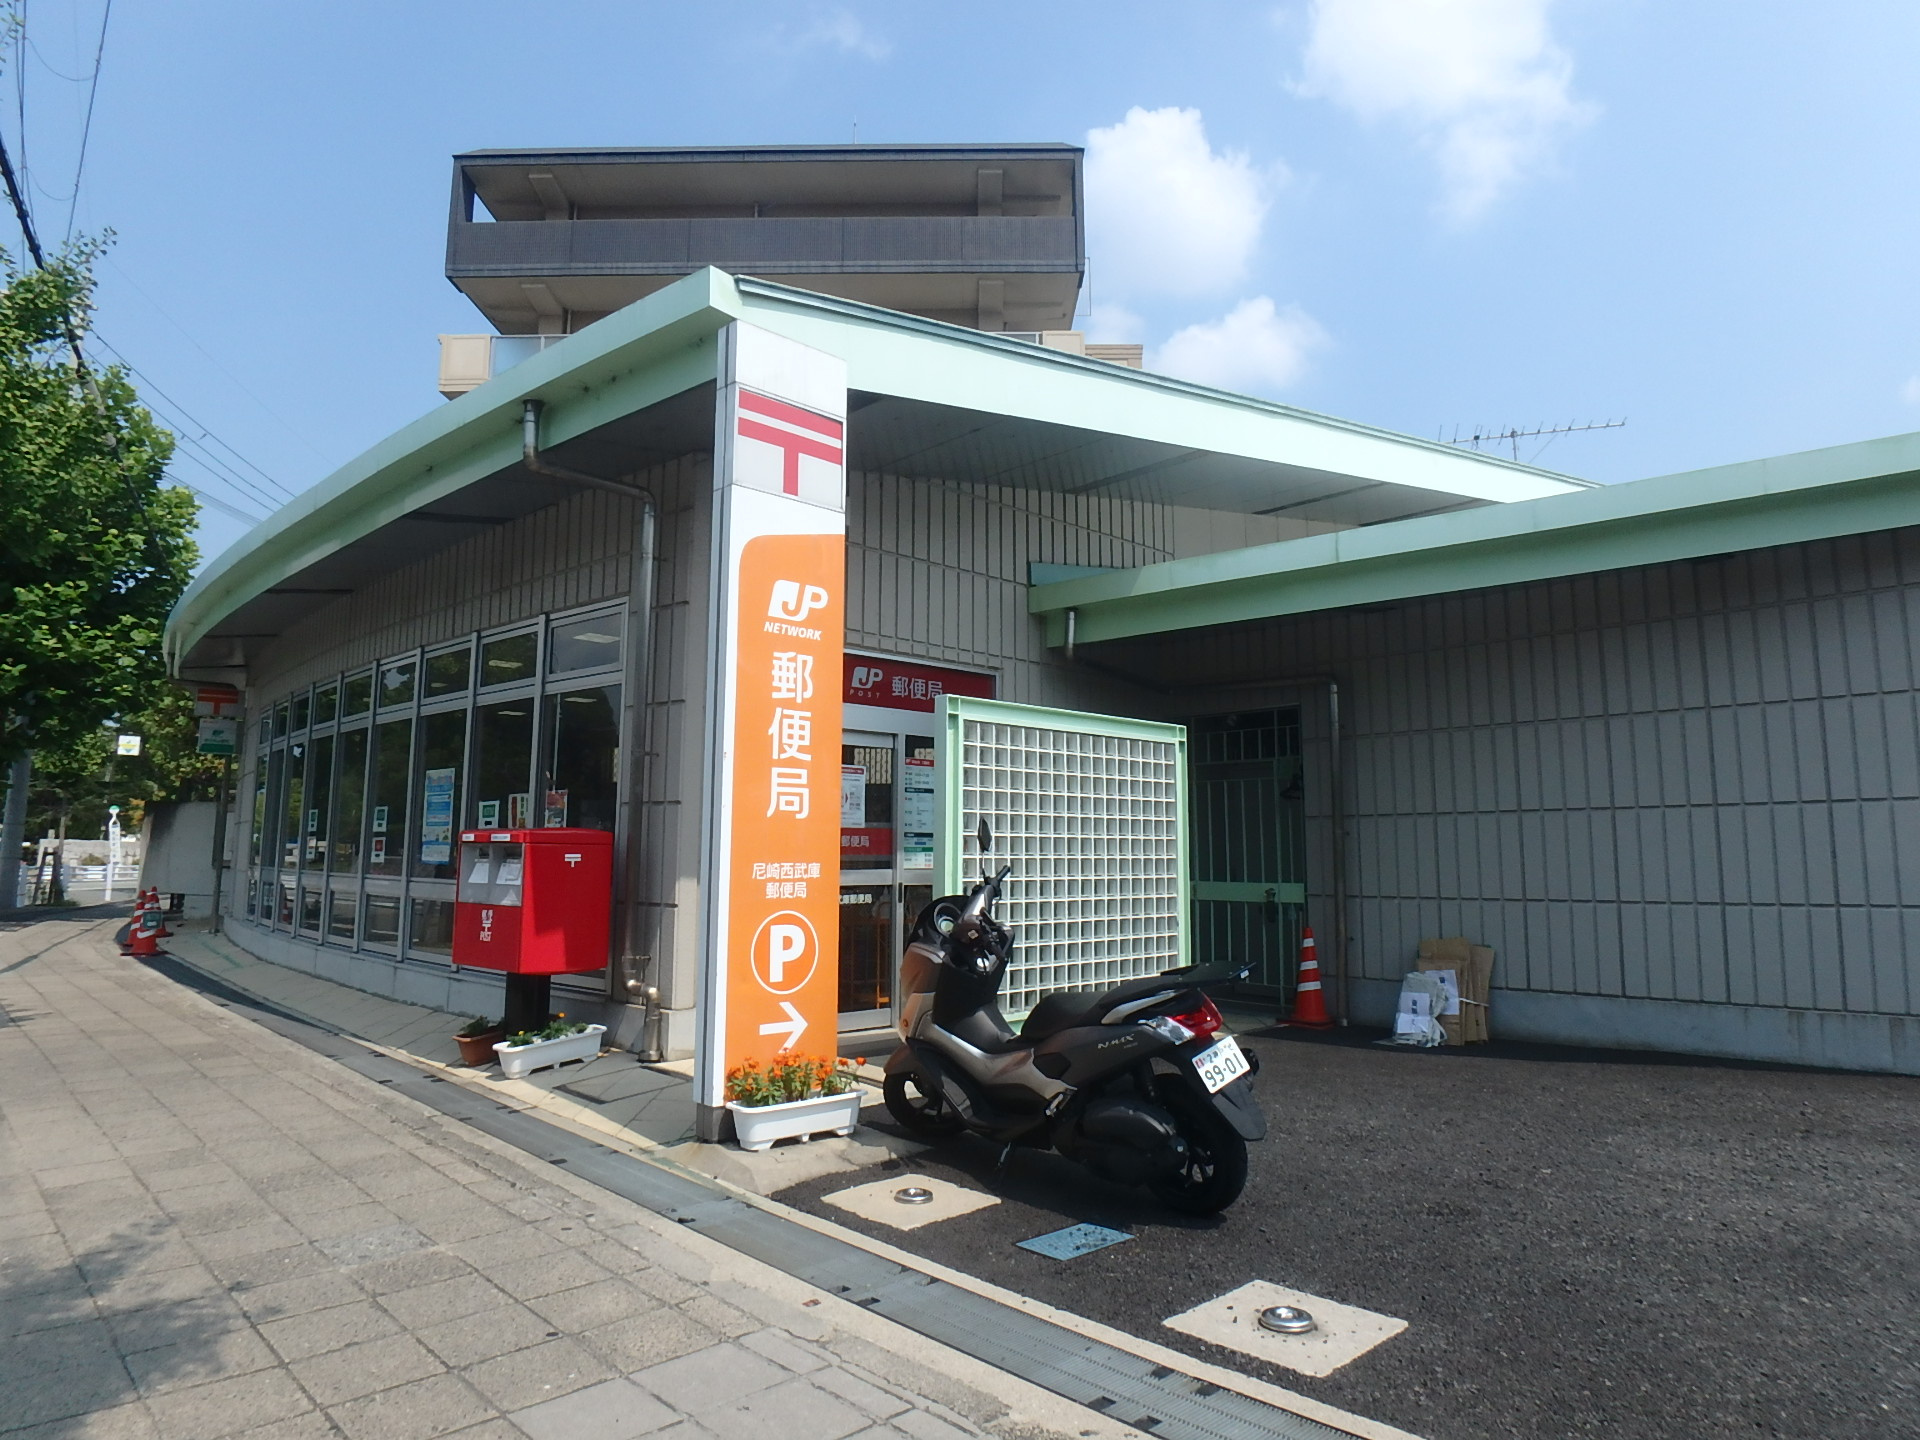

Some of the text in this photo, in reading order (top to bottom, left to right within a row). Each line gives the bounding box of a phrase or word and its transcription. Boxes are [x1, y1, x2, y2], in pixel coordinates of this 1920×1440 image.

[768, 579, 828, 622] JP
[763, 621, 823, 641] NETWORK
[849, 688, 881, 699] POST
[891, 675, 944, 700] 郵便局
[766, 651, 814, 820] 郵便局
[752, 862, 821, 880] 尼崎西武庫
[765, 882, 807, 899] 郵便局
[769, 924, 807, 983] P
